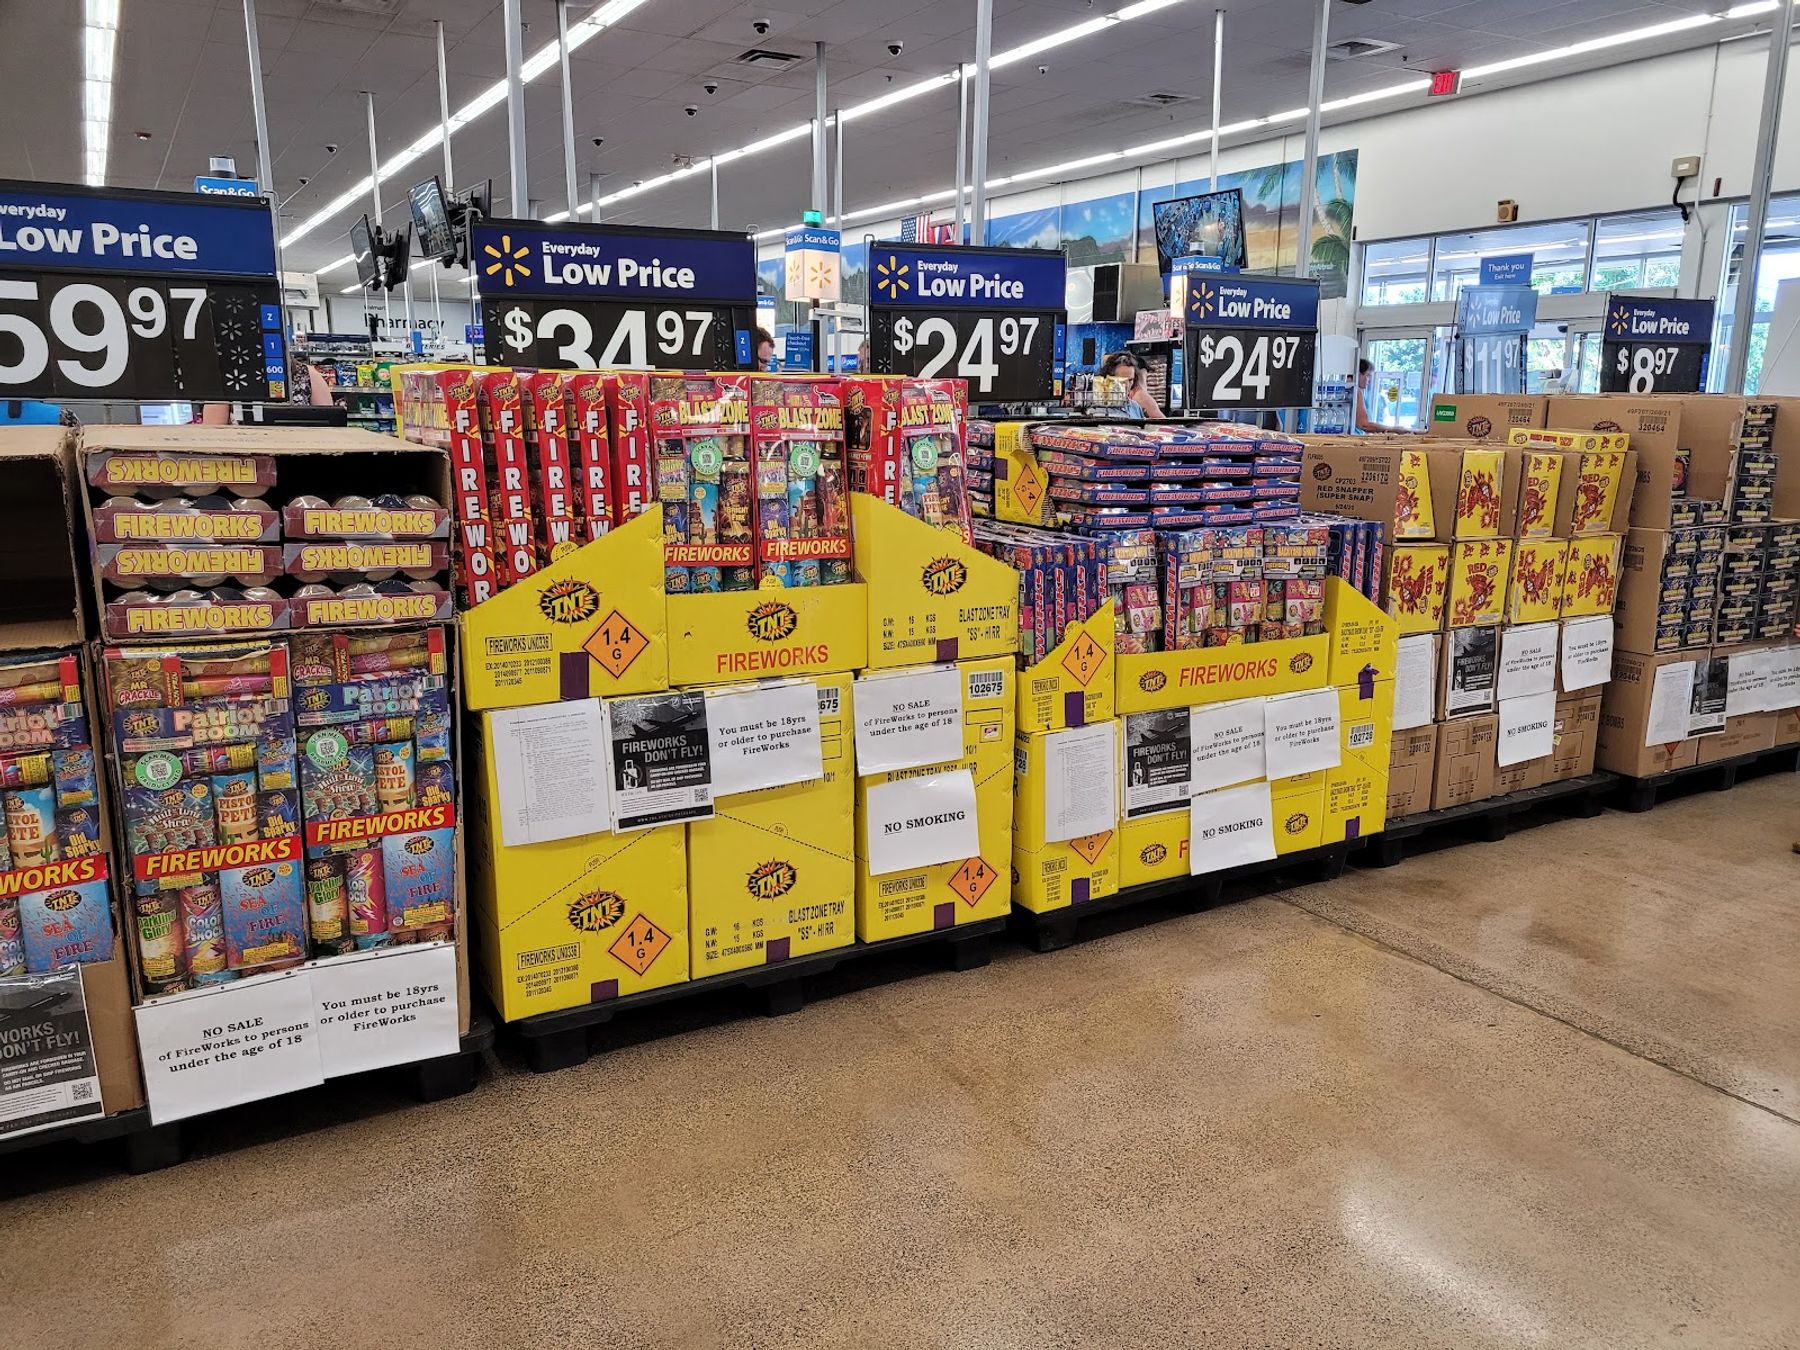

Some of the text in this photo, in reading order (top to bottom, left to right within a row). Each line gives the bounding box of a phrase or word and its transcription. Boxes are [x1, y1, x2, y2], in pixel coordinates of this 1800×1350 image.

[0, 203, 67, 222] veryday
[91, 222, 198, 260] Price
[542, 241, 600, 260] Everyday
[543, 255, 695, 289] Low Price
[917, 260, 959, 273] Everyday
[1488, 263, 1525, 273] Thank you
[917, 273, 1025, 299] Low Price
[1219, 286, 1248, 298] Everyday
[1218, 296, 1291, 320] Low Price
[1483, 305, 1521, 326] Low Price
[1633, 308, 1656, 318] Everyday
[1632, 316, 1690, 335] Low Price
[266, 365, 284, 375] 600
[720, 400, 750, 424] ZONE
[778, 407, 842, 430] BLAST ZONE
[106, 457, 257, 483] FIREWORKS
[1316, 492, 1374, 504] (SUPER SNAP)
[1336, 485, 1374, 495] SNAPPER
[455, 409, 491, 603] FIREWOR
[114, 513, 263, 539] FIREWORKS
[304, 510, 436, 535] FIREWORKS
[301, 545, 432, 571] FIREWORKS
[665, 546, 750, 562] FIREWORKS
[767, 539, 847, 557] FIREWORKS
[116, 550, 264, 574] FIREWORKS
[127, 605, 274, 632] FIREWORKS
[307, 595, 437, 624] FIREWORKS
[489, 638, 526, 654] FIREWORKS
[602, 626, 631, 646] 1.4
[612, 648, 622, 660] G
[716, 645, 829, 674] FIREWORKS
[1074, 643, 1095, 662] 1.4
[1457, 655, 1487, 668] FIREWORKS
[1081, 661, 1088, 672] G
[1179, 657, 1278, 688] FIREWORKS
[968, 682, 1003, 694] 102675
[892, 700, 931, 713] NO SALE
[719, 715, 806, 735] You must be 18yrs
[863, 719, 874, 727] of
[874, 713, 916, 726] FireWorks
[927, 708, 958, 719] persons
[1289, 721, 1305, 730] must
[1305, 719, 1313, 727] be
[1314, 716, 1332, 726] 18yrs
[731, 736, 755, 746] older
[770, 726, 812, 741] purchase
[869, 718, 953, 738] under the age of 18
[1213, 726, 1243, 739] NO SALE
[1282, 732, 1298, 741] older
[1307, 725, 1335, 737] purchase
[1507, 721, 1548, 737] NO SMOKING
[622, 735, 687, 755] FIREWORKS
[742, 741, 790, 755] FireWorks
[1132, 741, 1177, 758] FIREWORKS
[1192, 746, 1199, 754] of
[1200, 739, 1232, 753] FireWorks
[1241, 731, 1265, 744] persons
[1197, 740, 1261, 762] under the age of 18
[1289, 736, 1320, 748] FireWorks
[644, 745, 704, 763] DON'T FLY!
[1147, 749, 1188, 765] DON'T FLY!
[317, 806, 446, 843] FIREWORKS
[884, 811, 966, 835] NO SMOKING
[1202, 818, 1264, 839] NO SMOKING
[146, 839, 292, 876] FIREWORKS
[963, 865, 985, 881] 1.4
[969, 882, 977, 892] G
[788, 907, 809, 923] BLAST
[829, 900, 845, 917] TRAY
[627, 927, 655, 947] 1.4
[520, 949, 556, 968] FIREWORKS
[636, 948, 646, 959] G
[321, 983, 440, 1012] You must be 18yrs
[319, 994, 446, 1025] or older to purchase
[201, 1017, 264, 1039] NO SALE
[353, 1013, 417, 1032] FireWorks
[46, 1030, 80, 1051] FLY!
[158, 1020, 309, 1063] of FireWorks to persons
[169, 1034, 303, 1073] under the age of 18
